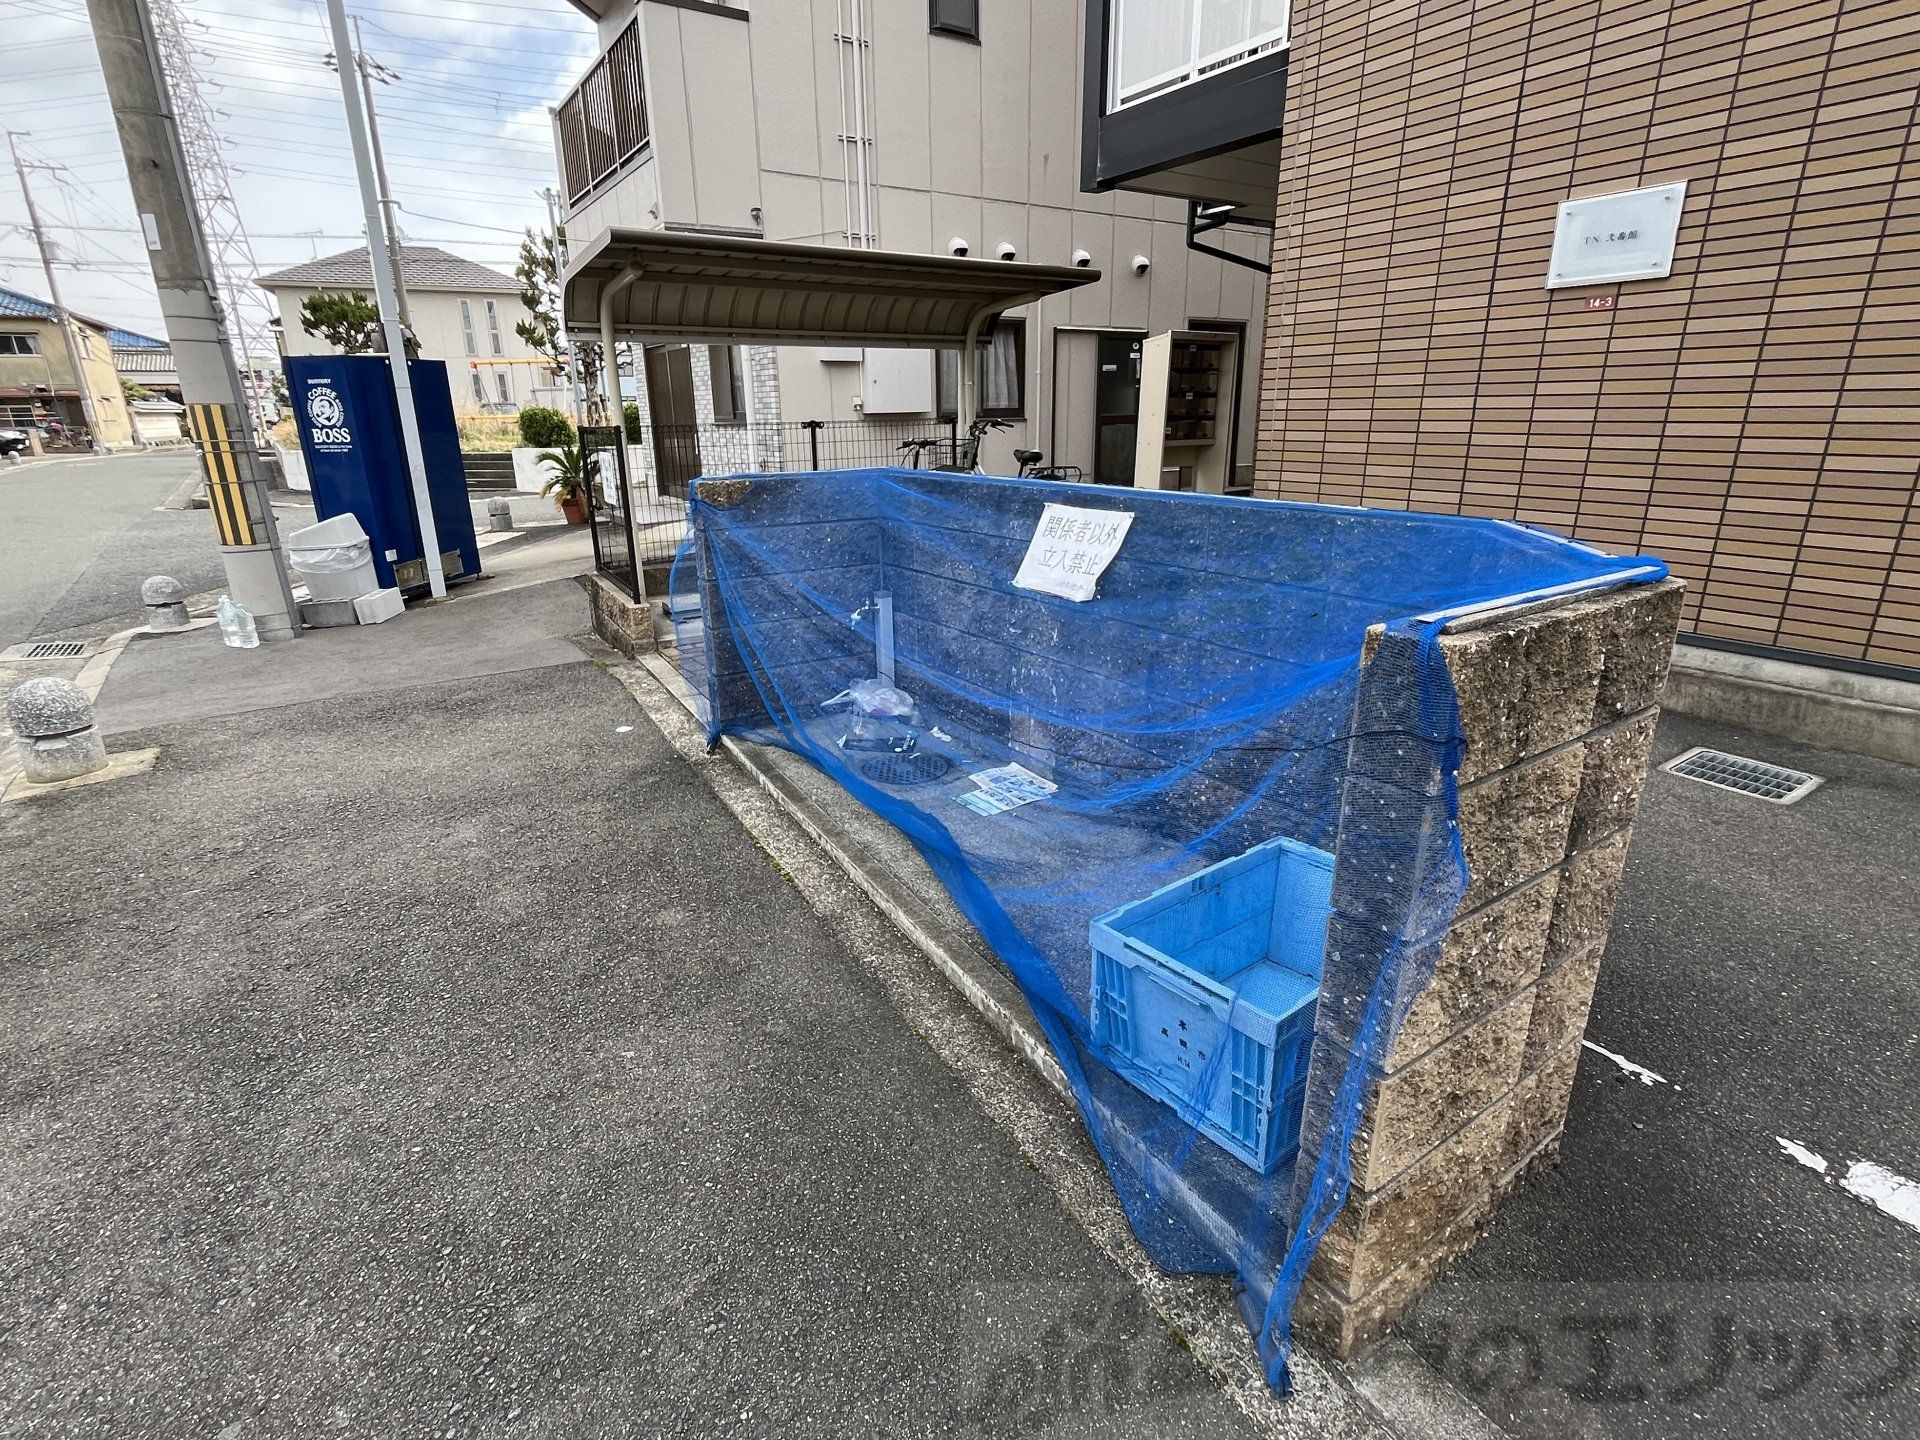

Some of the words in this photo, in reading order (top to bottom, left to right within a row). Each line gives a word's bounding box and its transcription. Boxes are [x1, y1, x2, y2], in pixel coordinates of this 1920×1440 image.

[1584, 236, 1600, 245] TN
[1589, 297, 1613, 308] 14-3
[307, 386, 338, 400] COFFEE
[311, 428, 351, 443] BOSS
[1042, 514, 1120, 547] 関係者以外
[1038, 545, 1099, 577] 立入禁止
